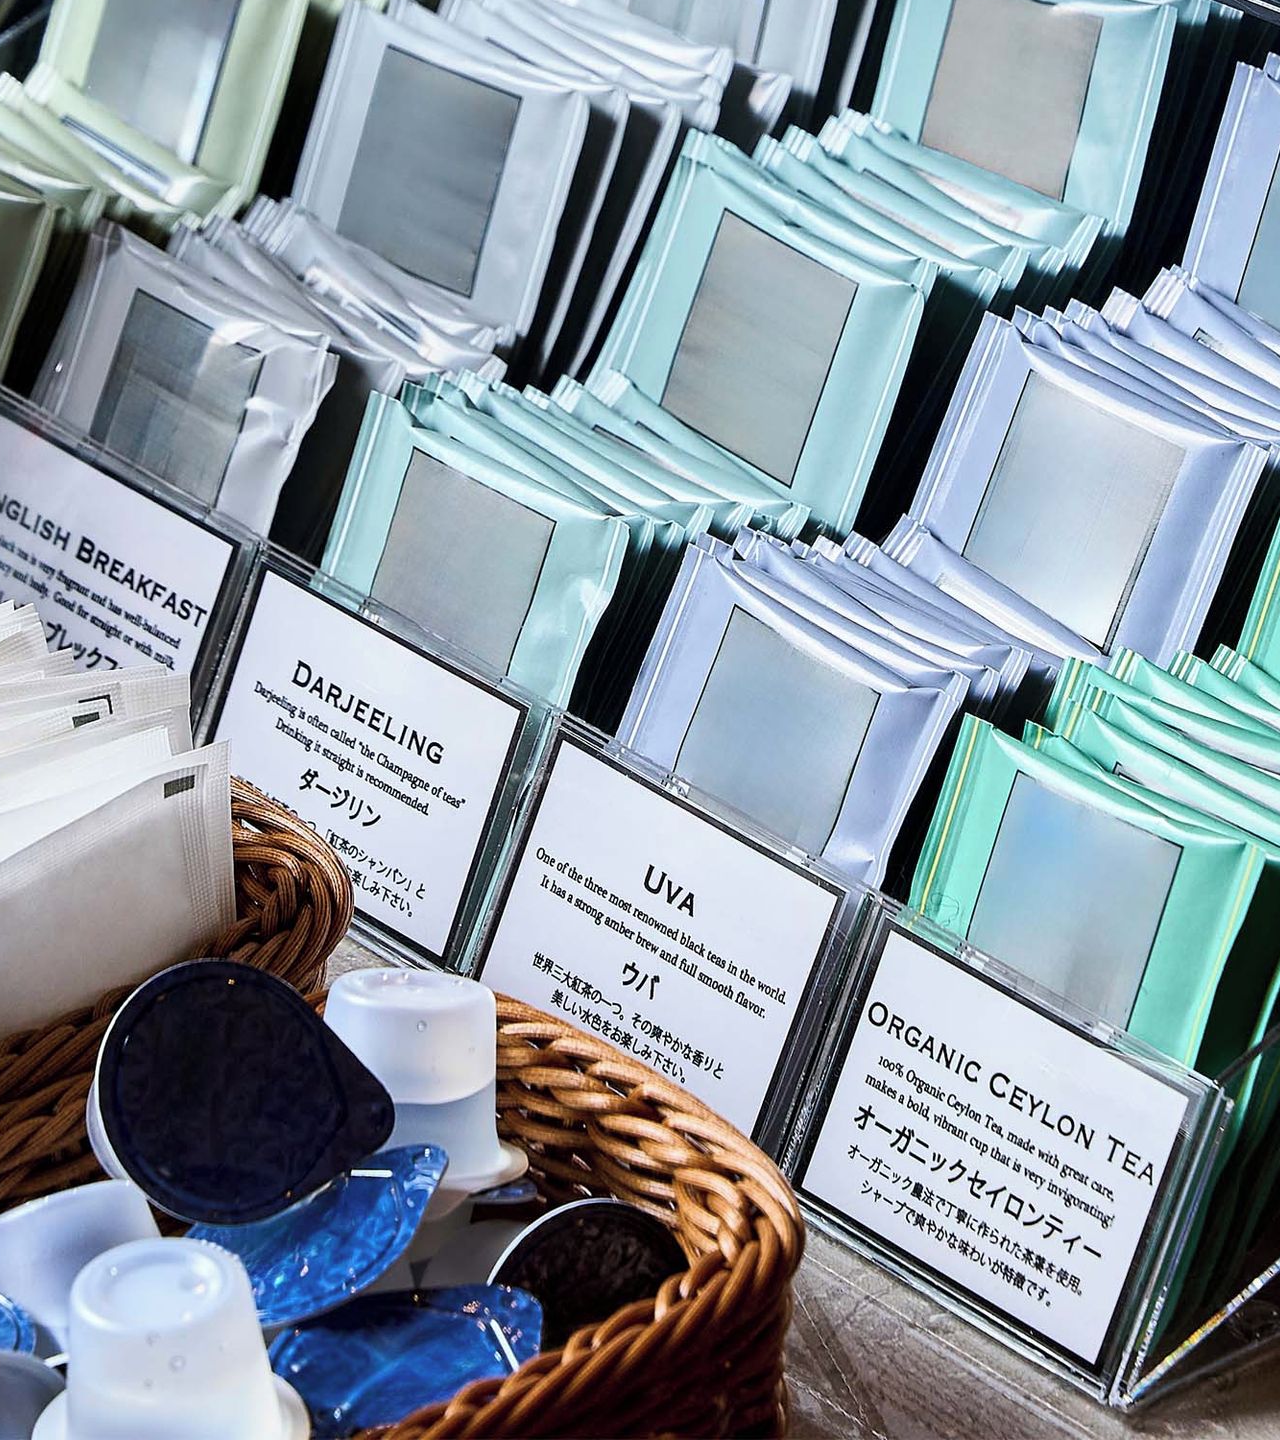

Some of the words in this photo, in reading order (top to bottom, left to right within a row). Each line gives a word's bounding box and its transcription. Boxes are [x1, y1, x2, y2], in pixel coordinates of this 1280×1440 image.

[75, 535, 208, 628] BREAKFAST
[253, 680, 298, 719] Darjeeling
[297, 706, 306, 720] is
[306, 714, 329, 734] often
[329, 728, 357, 750] called
[376, 752, 431, 792] Champagne
[430, 786, 445, 799] of
[275, 717, 314, 753] Drinking
[313, 740, 322, 754] it
[321, 747, 356, 774] straight
[355, 764, 365, 779] is
[364, 772, 430, 816] recommended.
[291, 659, 445, 765] DARJEELING
[298, 768, 382, 827] ダージリン
[536, 847, 556, 868] One
[556, 862, 570, 875] of
[567, 866, 584, 884] the
[583, 876, 609, 899] three
[607, 893, 633, 914] most
[632, 907, 680, 942] renowned
[679, 931, 706, 958] black
[706, 950, 727, 970] teas
[726, 960, 738, 977] in
[739, 968, 756, 987] the
[757, 980, 787, 1005] world.
[539, 874, 550, 889] It
[549, 879, 567, 900] has
[566, 893, 574, 904] a
[573, 897, 605, 926] strong
[603, 916, 636, 941] amber
[635, 931, 660, 955] brew
[658, 949, 679, 967] and
[678, 957, 699, 979] full
[697, 971, 734, 1001] smooth
[734, 991, 766, 1019] flavor.
[643, 864, 695, 918] UVA
[532, 951, 724, 1080] 世界三大紅茶の一つ。その爽やかな香りと
[550, 988, 686, 1084] 美しい水色をお楽しみ下さい。
[622, 961, 661, 1001] ウバ
[864, 1074, 898, 1100] makes
[897, 1094, 905, 1105] a
[906, 1095, 930, 1122] bold,
[933, 1113, 969, 1143] vibrant
[969, 1136, 989, 1157] cup
[989, 1146, 1011, 1168] that
[1011, 1158, 1022, 1173] is
[1024, 1167, 1047, 1190] very
[1046, 1178, 1116, 1230] invigorating!
[867, 1001, 982, 1083] ORGANIC
[989, 1072, 1096, 1150] CEYLON
[1107, 1134, 1154, 1186] TEA
[877, 1055, 905, 1079] 100%
[905, 1069, 946, 1102] Organic
[946, 1093, 982, 1124] Ceylon
[984, 1113, 1004, 1139] Tea,
[1006, 1131, 1036, 1155] made
[1037, 1148, 1060, 1170] with
[1059, 1164, 1090, 1186] great
[1090, 1180, 1114, 1203] care,
[853, 1104, 1102, 1258] オーガニックセイロンティー
